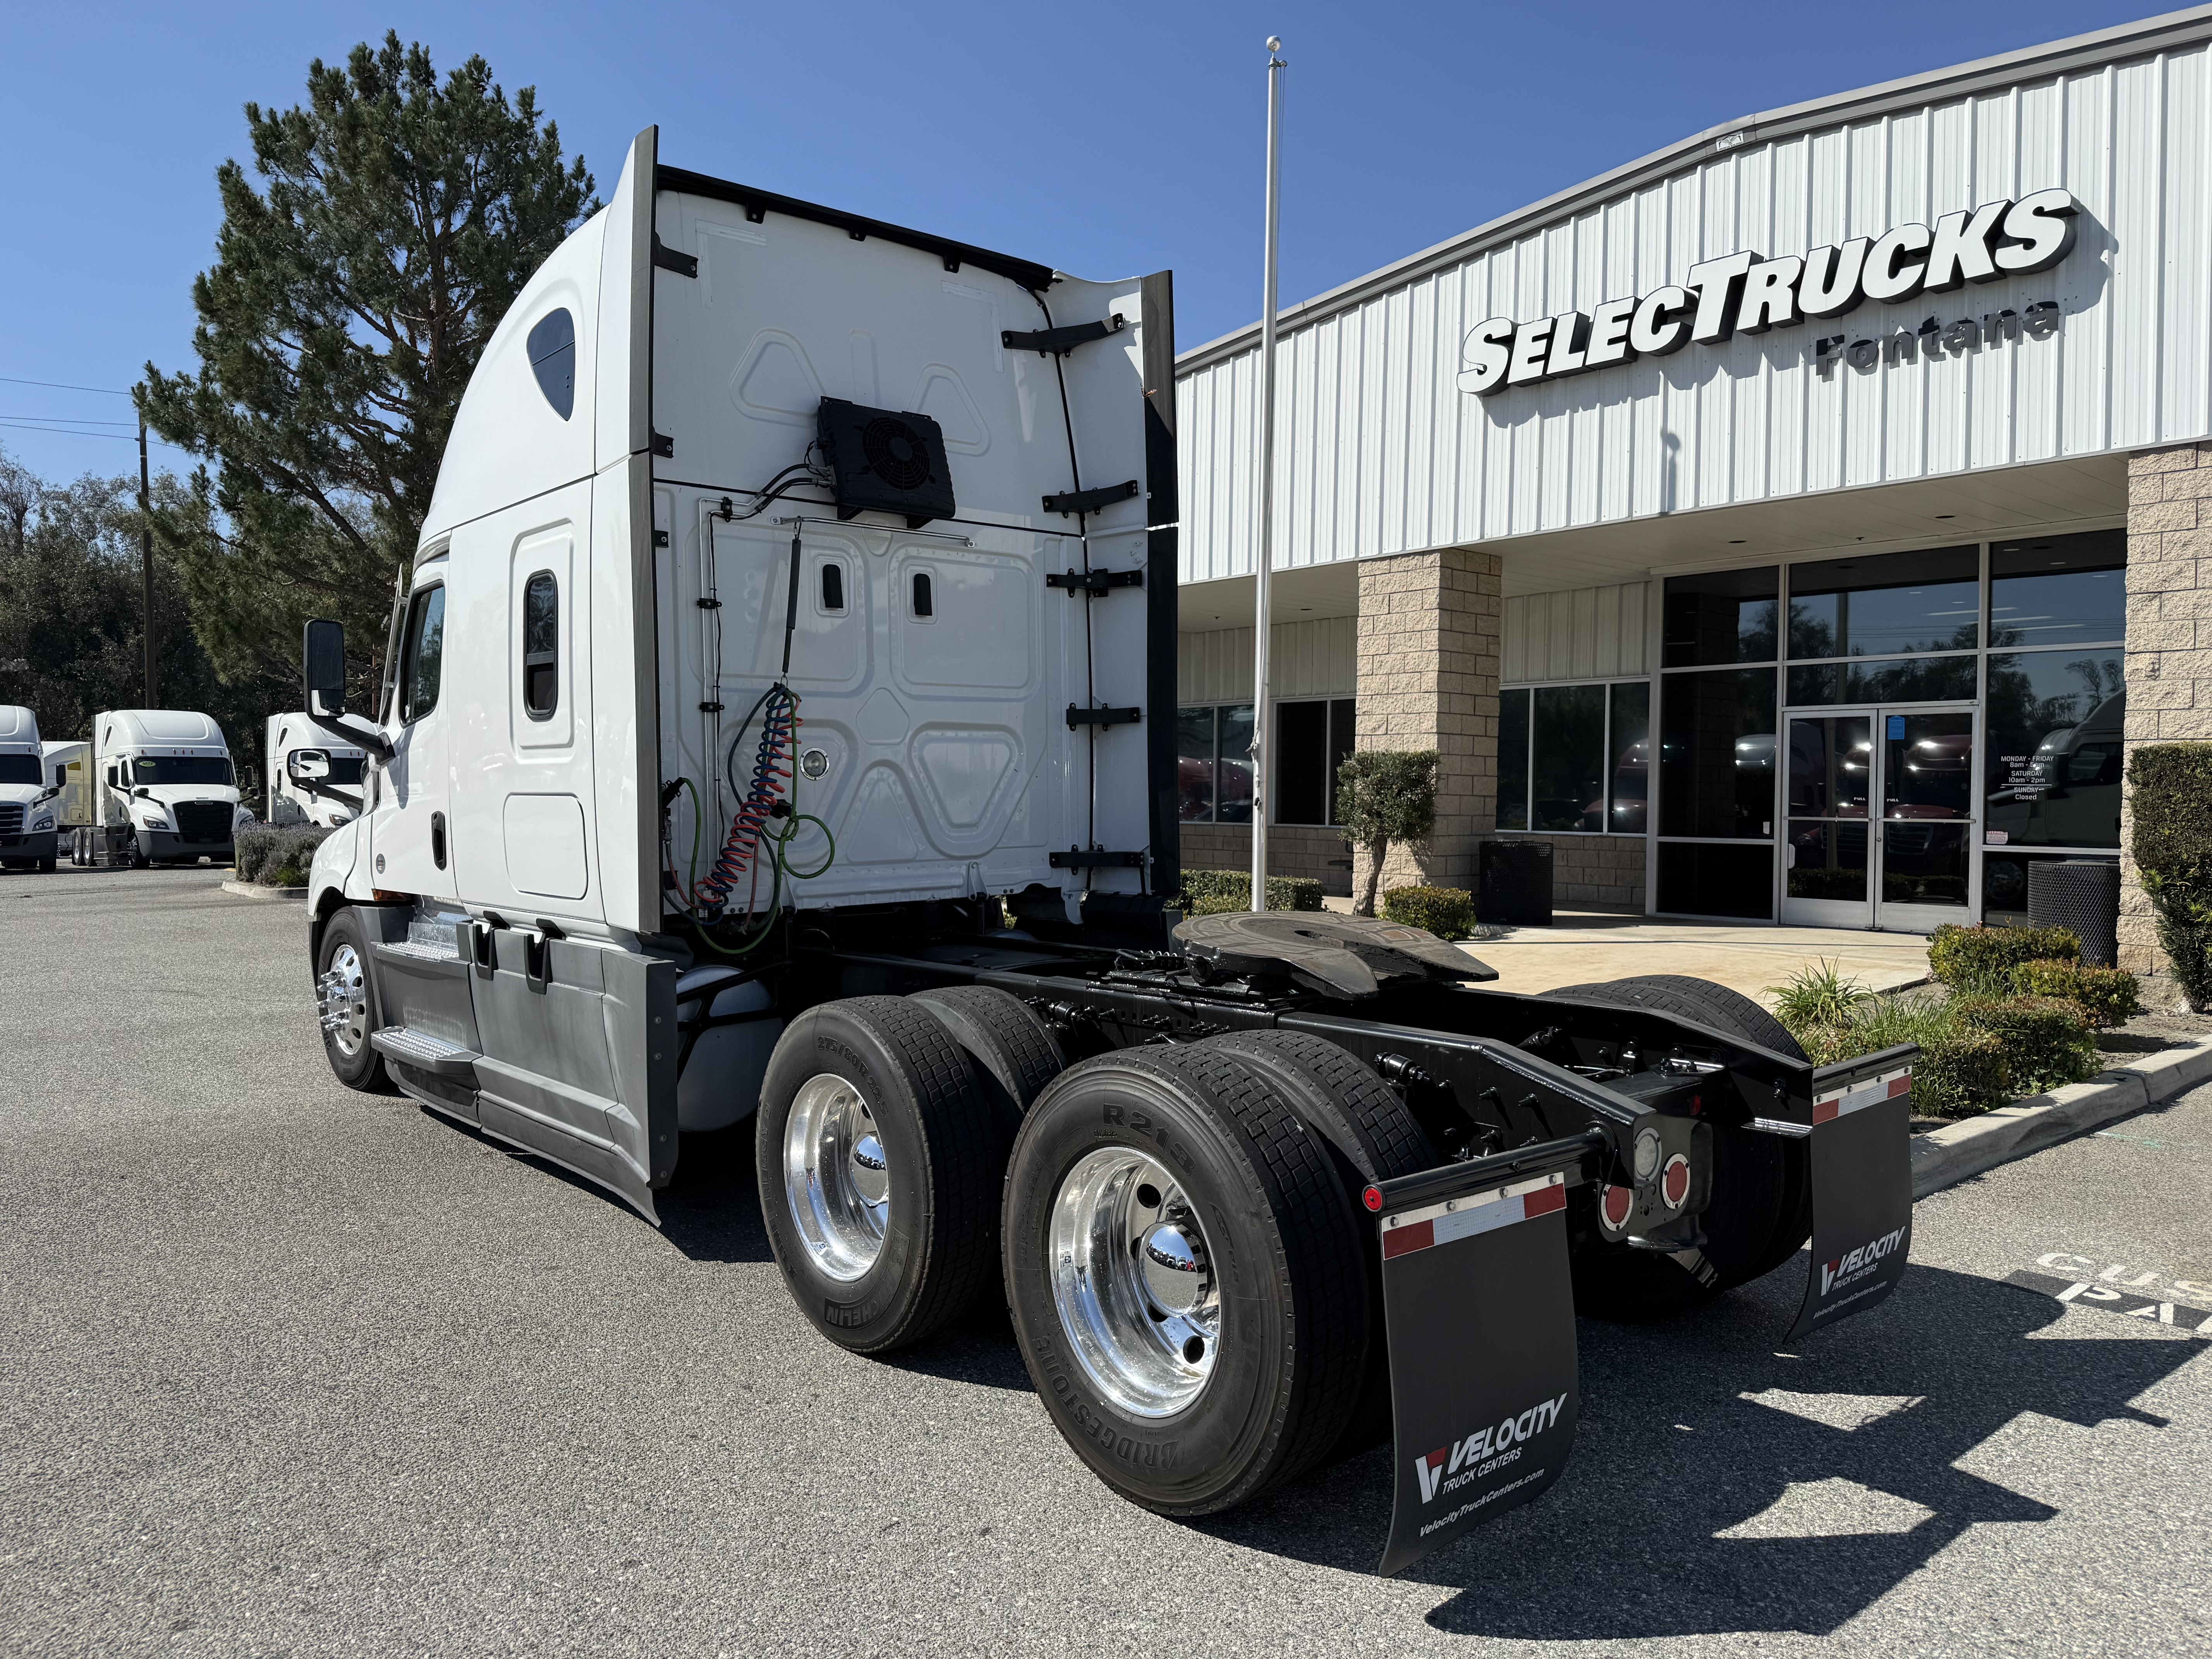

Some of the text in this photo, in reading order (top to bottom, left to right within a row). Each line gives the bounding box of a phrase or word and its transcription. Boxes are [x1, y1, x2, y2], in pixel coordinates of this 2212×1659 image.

[1816, 300, 2059, 376] Fontana
[1103, 1103, 1195, 1176] R213
[1831, 1262, 1879, 1291] TRUCK CENTERS
[1836, 1225, 1906, 1278] VELOCITY
[826, 1268, 896, 1326] MICHELIN
[1812, 1280, 1887, 1320] VelocityTruckCenters.com
[2055, 1282, 2212, 1333] PA
[1032, 1336, 1179, 1470] BRIDGESTONE
[1447, 1392, 1568, 1475] VELOCITY
[1442, 1446, 1523, 1495] TRUCK CENTERS
[1419, 1468, 1545, 1538] VelocityTruckCenters.com
